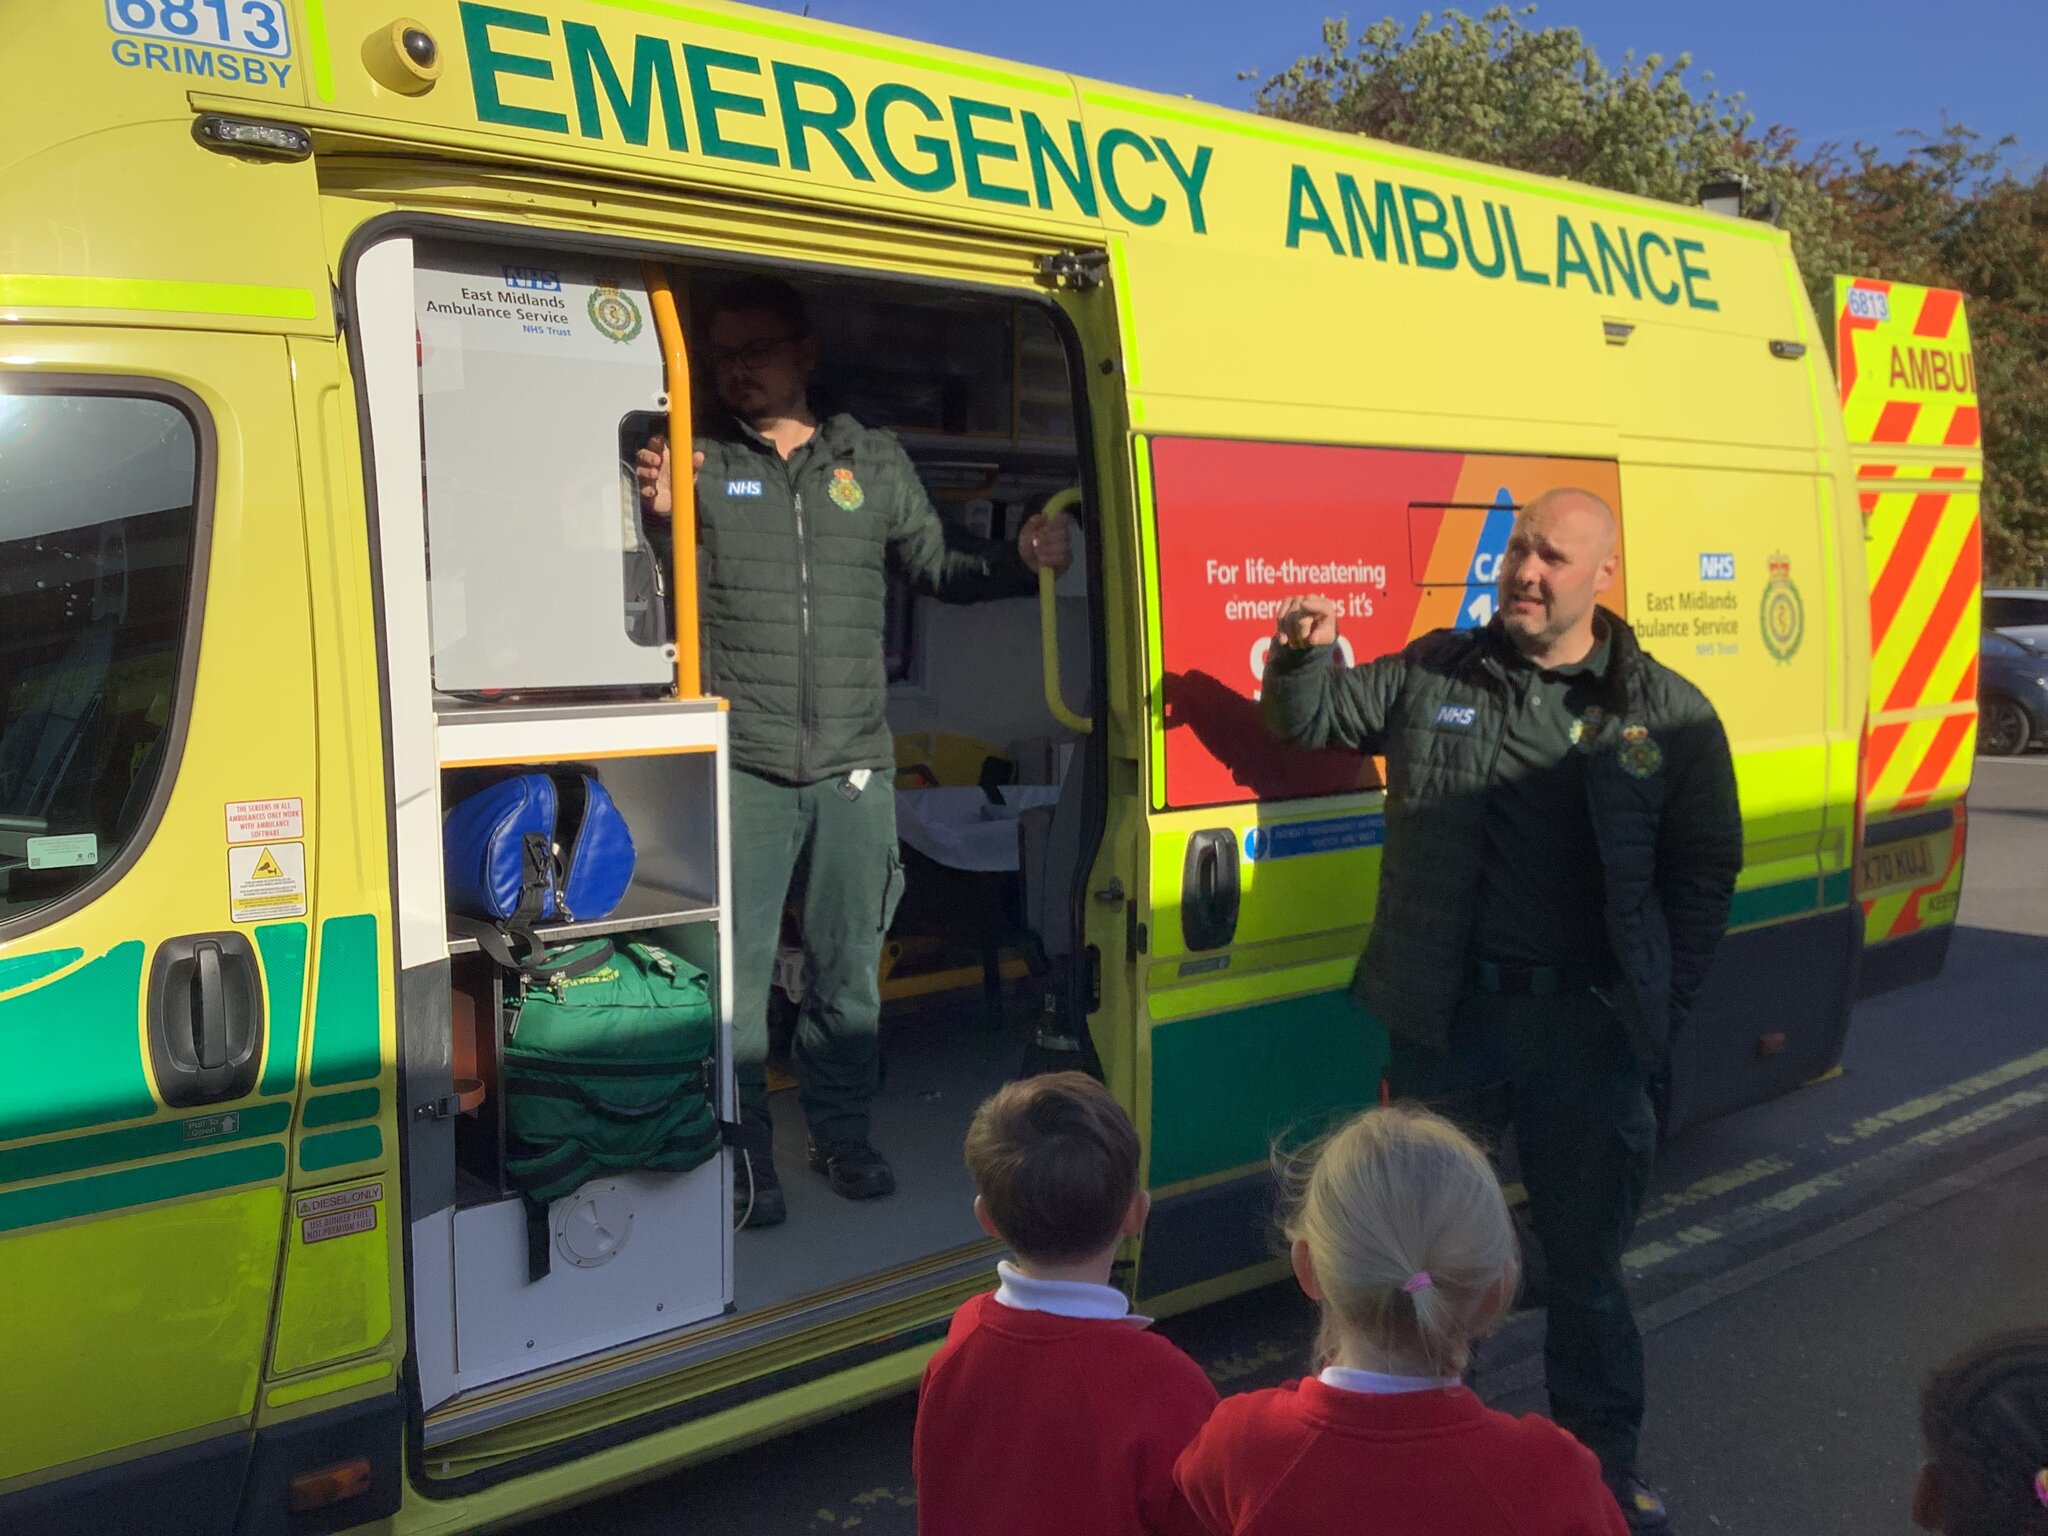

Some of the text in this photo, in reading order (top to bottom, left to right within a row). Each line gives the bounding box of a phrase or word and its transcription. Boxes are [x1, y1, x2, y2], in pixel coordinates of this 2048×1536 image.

[115, 0, 280, 49] 6813
[111, 39, 292, 88] GRIMSBY
[461, 1, 1720, 312] EMERGENCY AMBULANCE
[504, 266, 560, 291] NHS
[461, 288, 566, 309] East Midlands
[1849, 289, 1888, 318] 6813
[426, 301, 569, 325] Ambulance Service
[523, 325, 571, 336] NHS Trust
[728, 481, 762, 496] NHS
[1206, 557, 1386, 589] For life-threatening
[1701, 554, 1734, 579] NHS
[1647, 590, 1738, 612] East Midlands
[1635, 616, 1738, 638] bulance Service
[1437, 706, 1475, 725] NHS
[312, 1187, 380, 1211] DIESEL ONLY
